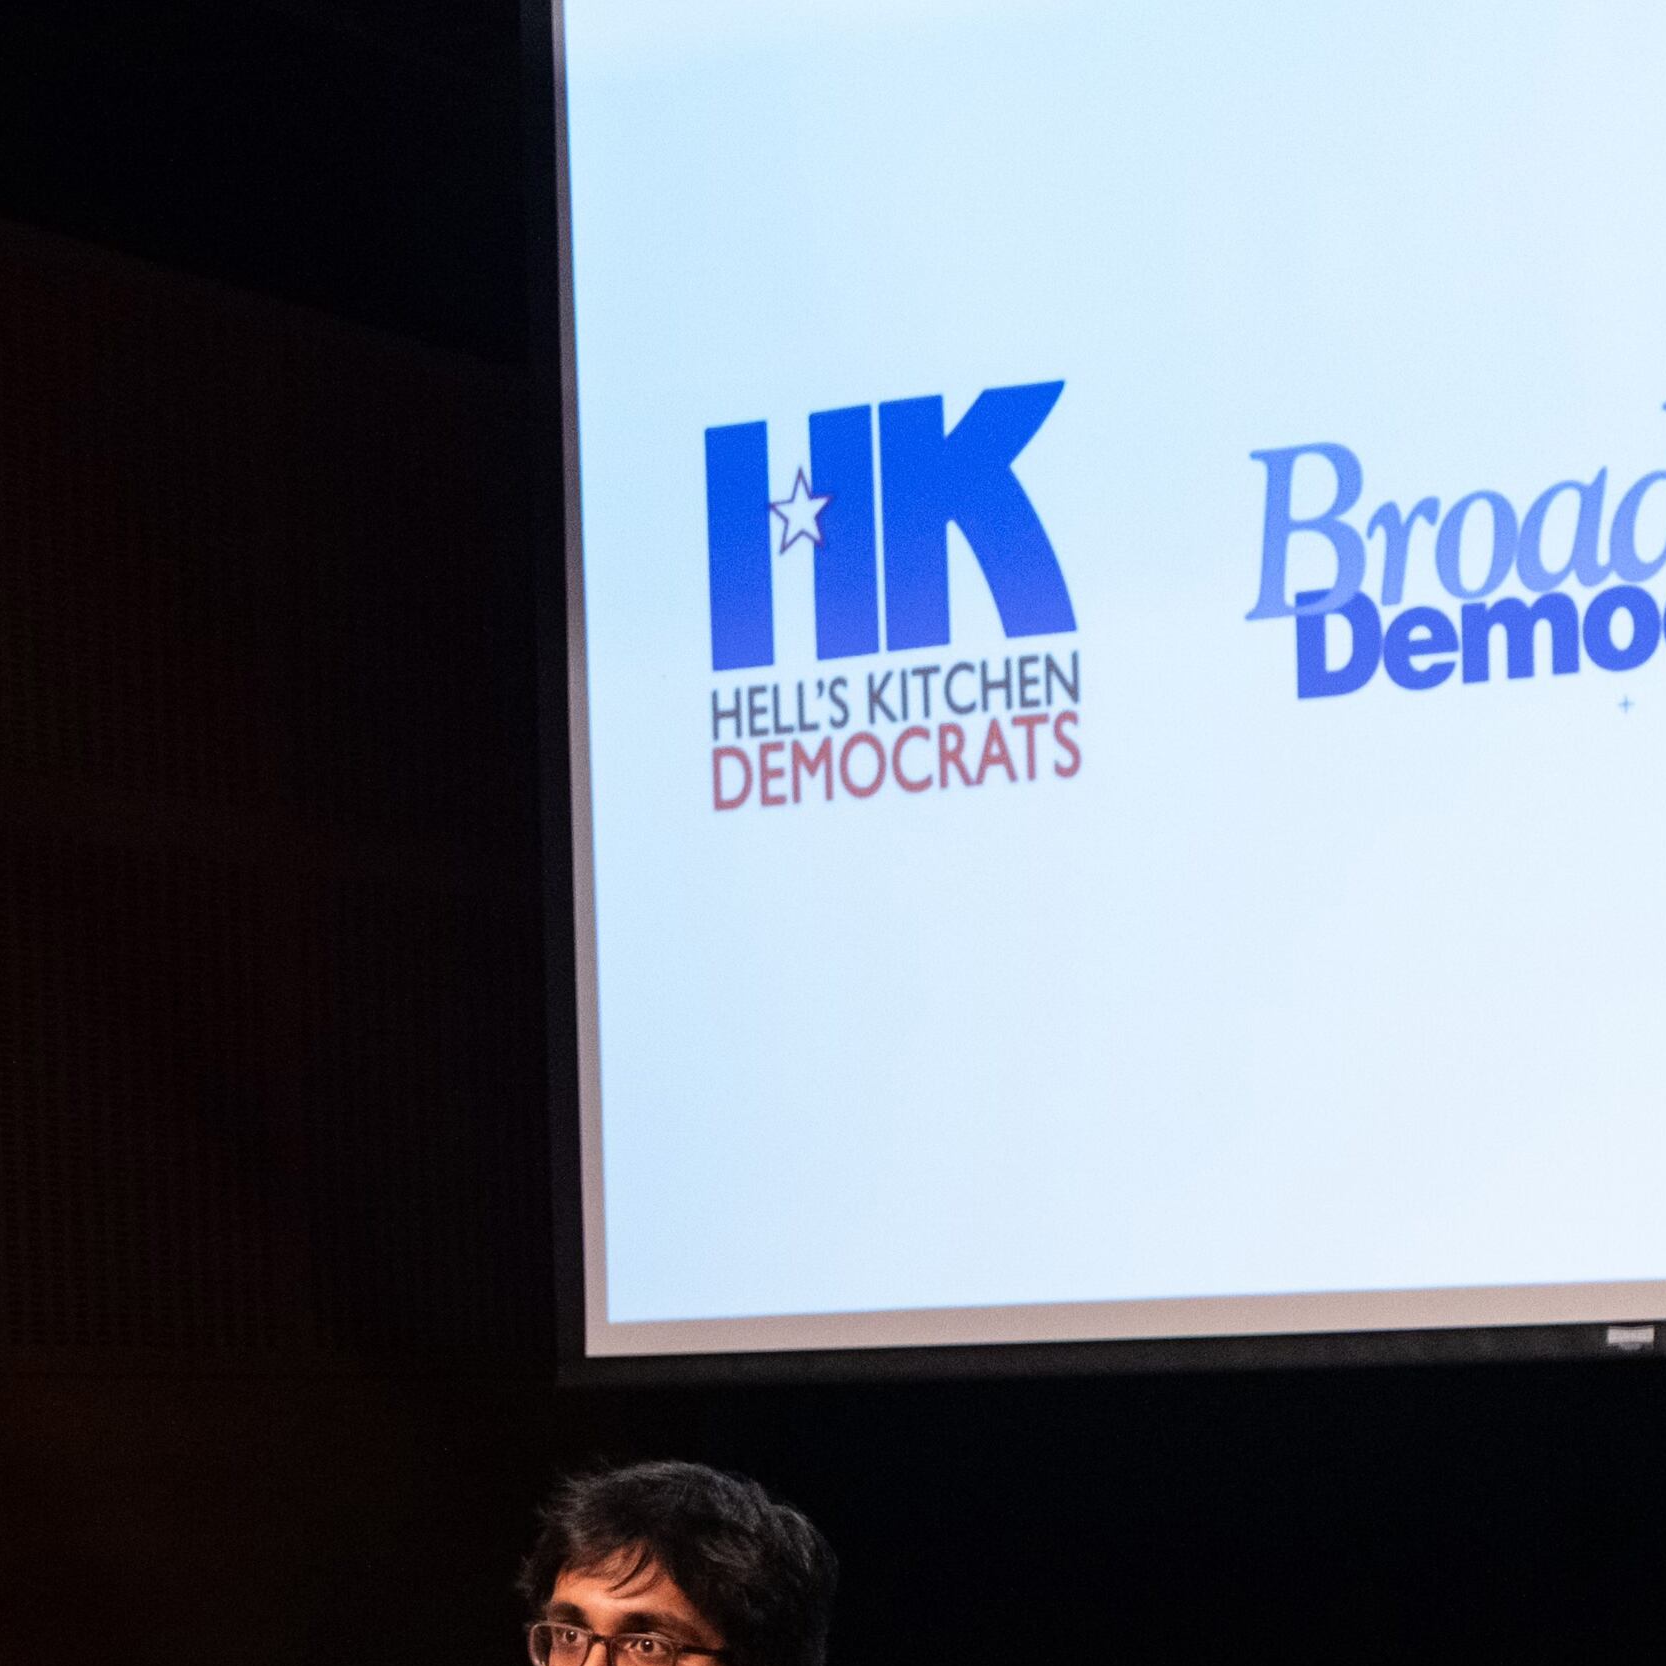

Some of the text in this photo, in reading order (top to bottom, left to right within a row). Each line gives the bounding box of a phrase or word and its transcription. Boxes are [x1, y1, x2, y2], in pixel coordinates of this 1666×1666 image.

[705, 379, 1077, 671] HK
[712, 651, 1081, 740] HELL'S KITCHEN
[712, 711, 1082, 811] DEMOCRATS
